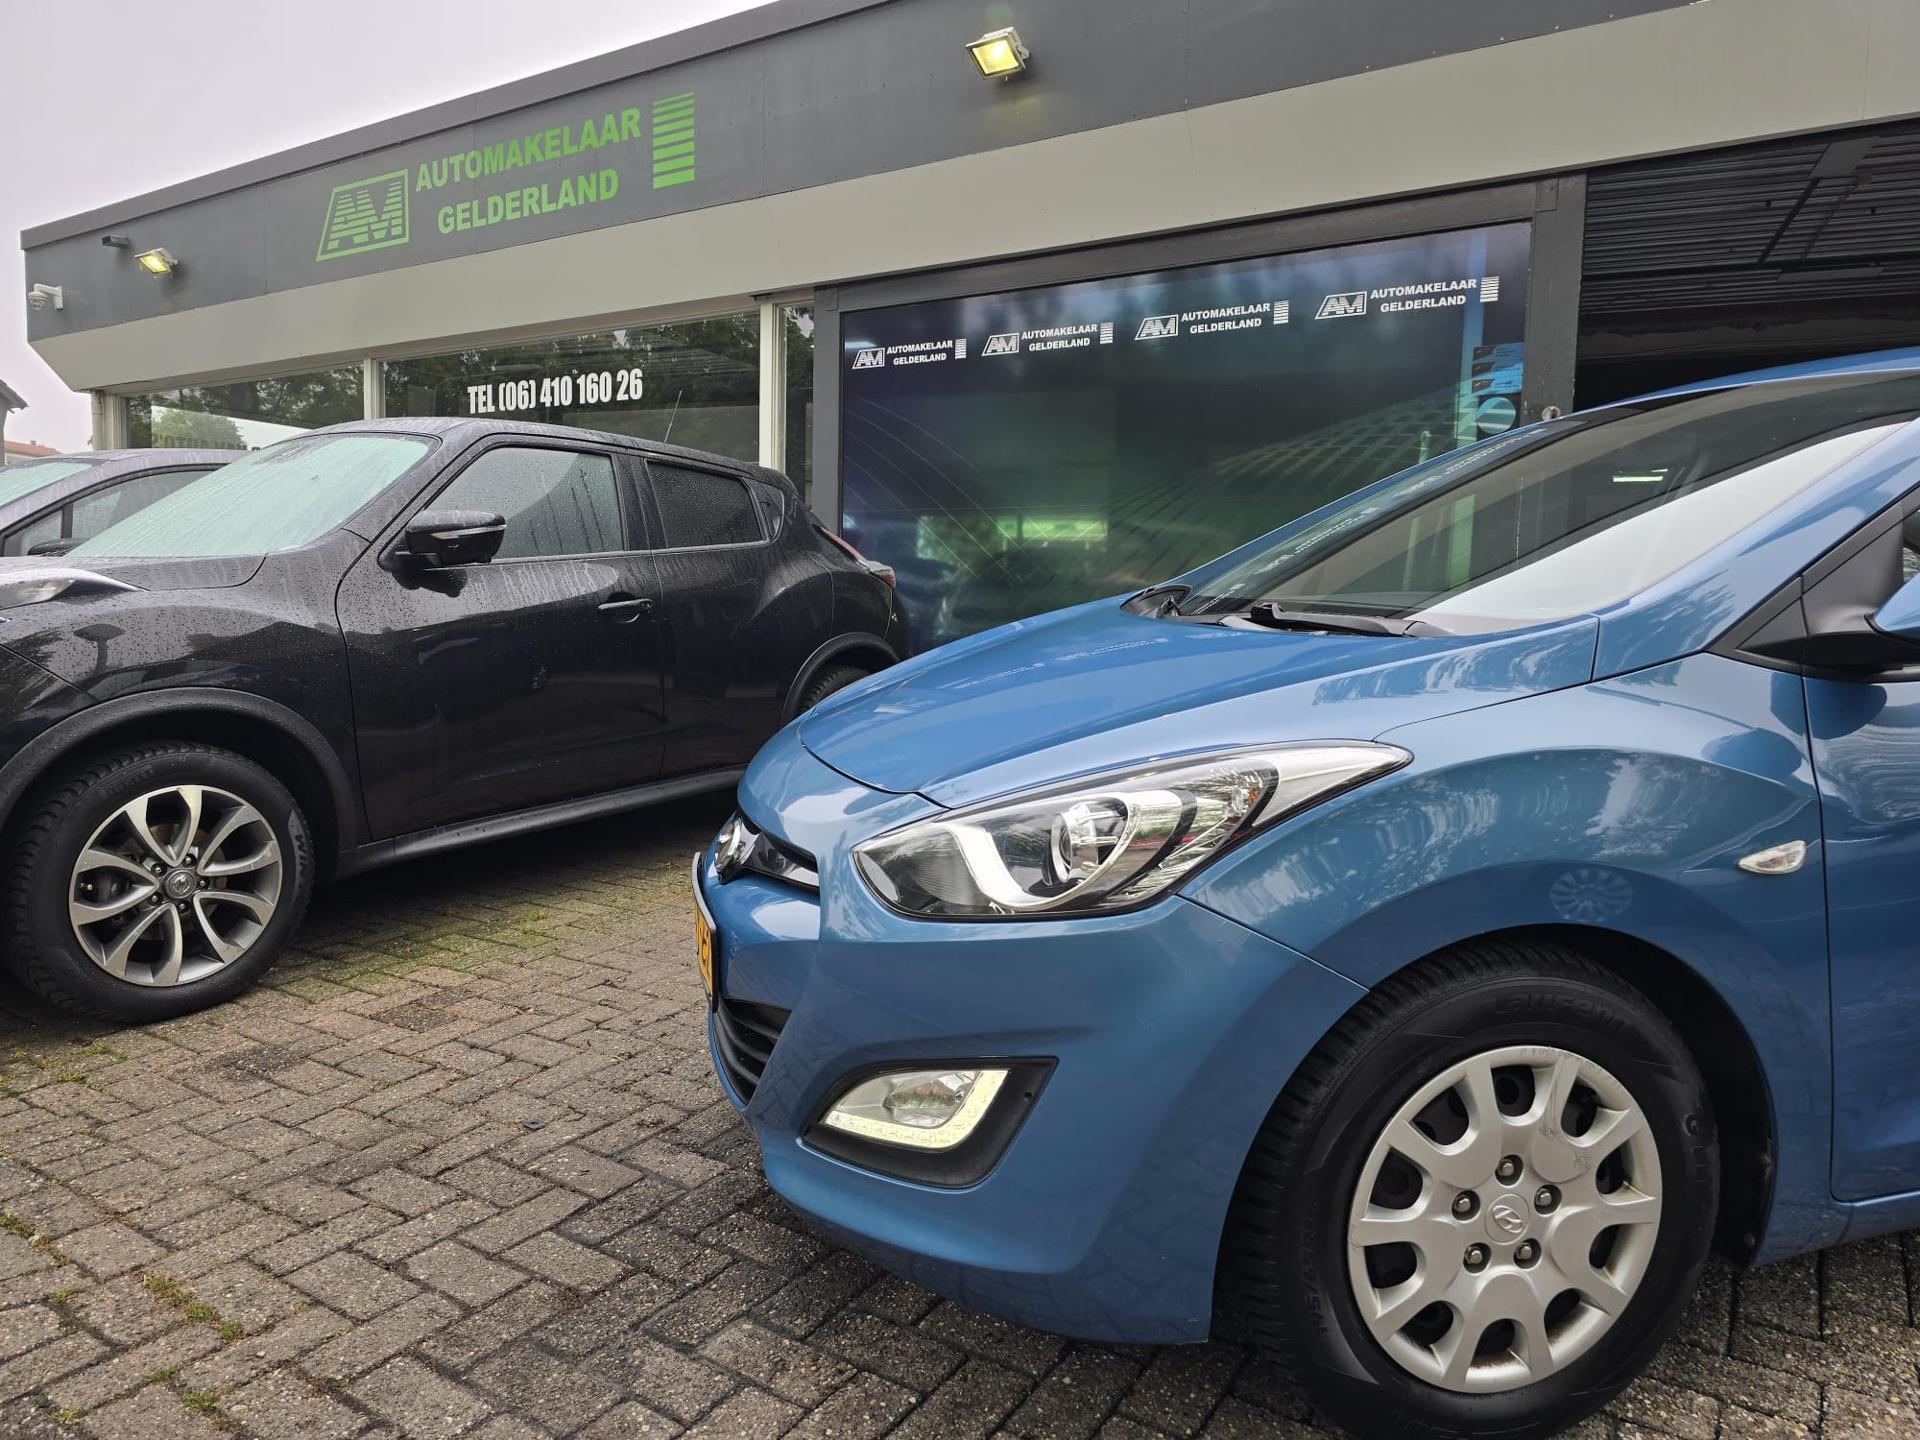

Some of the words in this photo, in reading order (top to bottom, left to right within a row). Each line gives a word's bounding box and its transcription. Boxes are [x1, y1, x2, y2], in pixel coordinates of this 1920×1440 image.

[416, 107, 642, 191] AUTOMAKELAAR
[437, 168, 619, 235] GELDERLAND
[1370, 278, 1477, 300] AUTOMAKELAAR
[1181, 302, 1271, 322] AUTOMAKELAAR
[1380, 295, 1466, 313] GELDERLAND
[1021, 323, 1098, 340] AUTOMAKELAAR
[1189, 318, 1262, 334] GELDERLAND
[886, 339, 953, 355] AUTOMAKELAAR
[1029, 337, 1091, 352] GELDERLAND
[893, 352, 947, 366] GELDERLAND
[467, 384, 495, 414] TEL
[499, 379, 536, 412] (06)
[540, 375, 573, 408] 410
[576, 371, 612, 404] 160
[616, 368, 643, 401] 26
